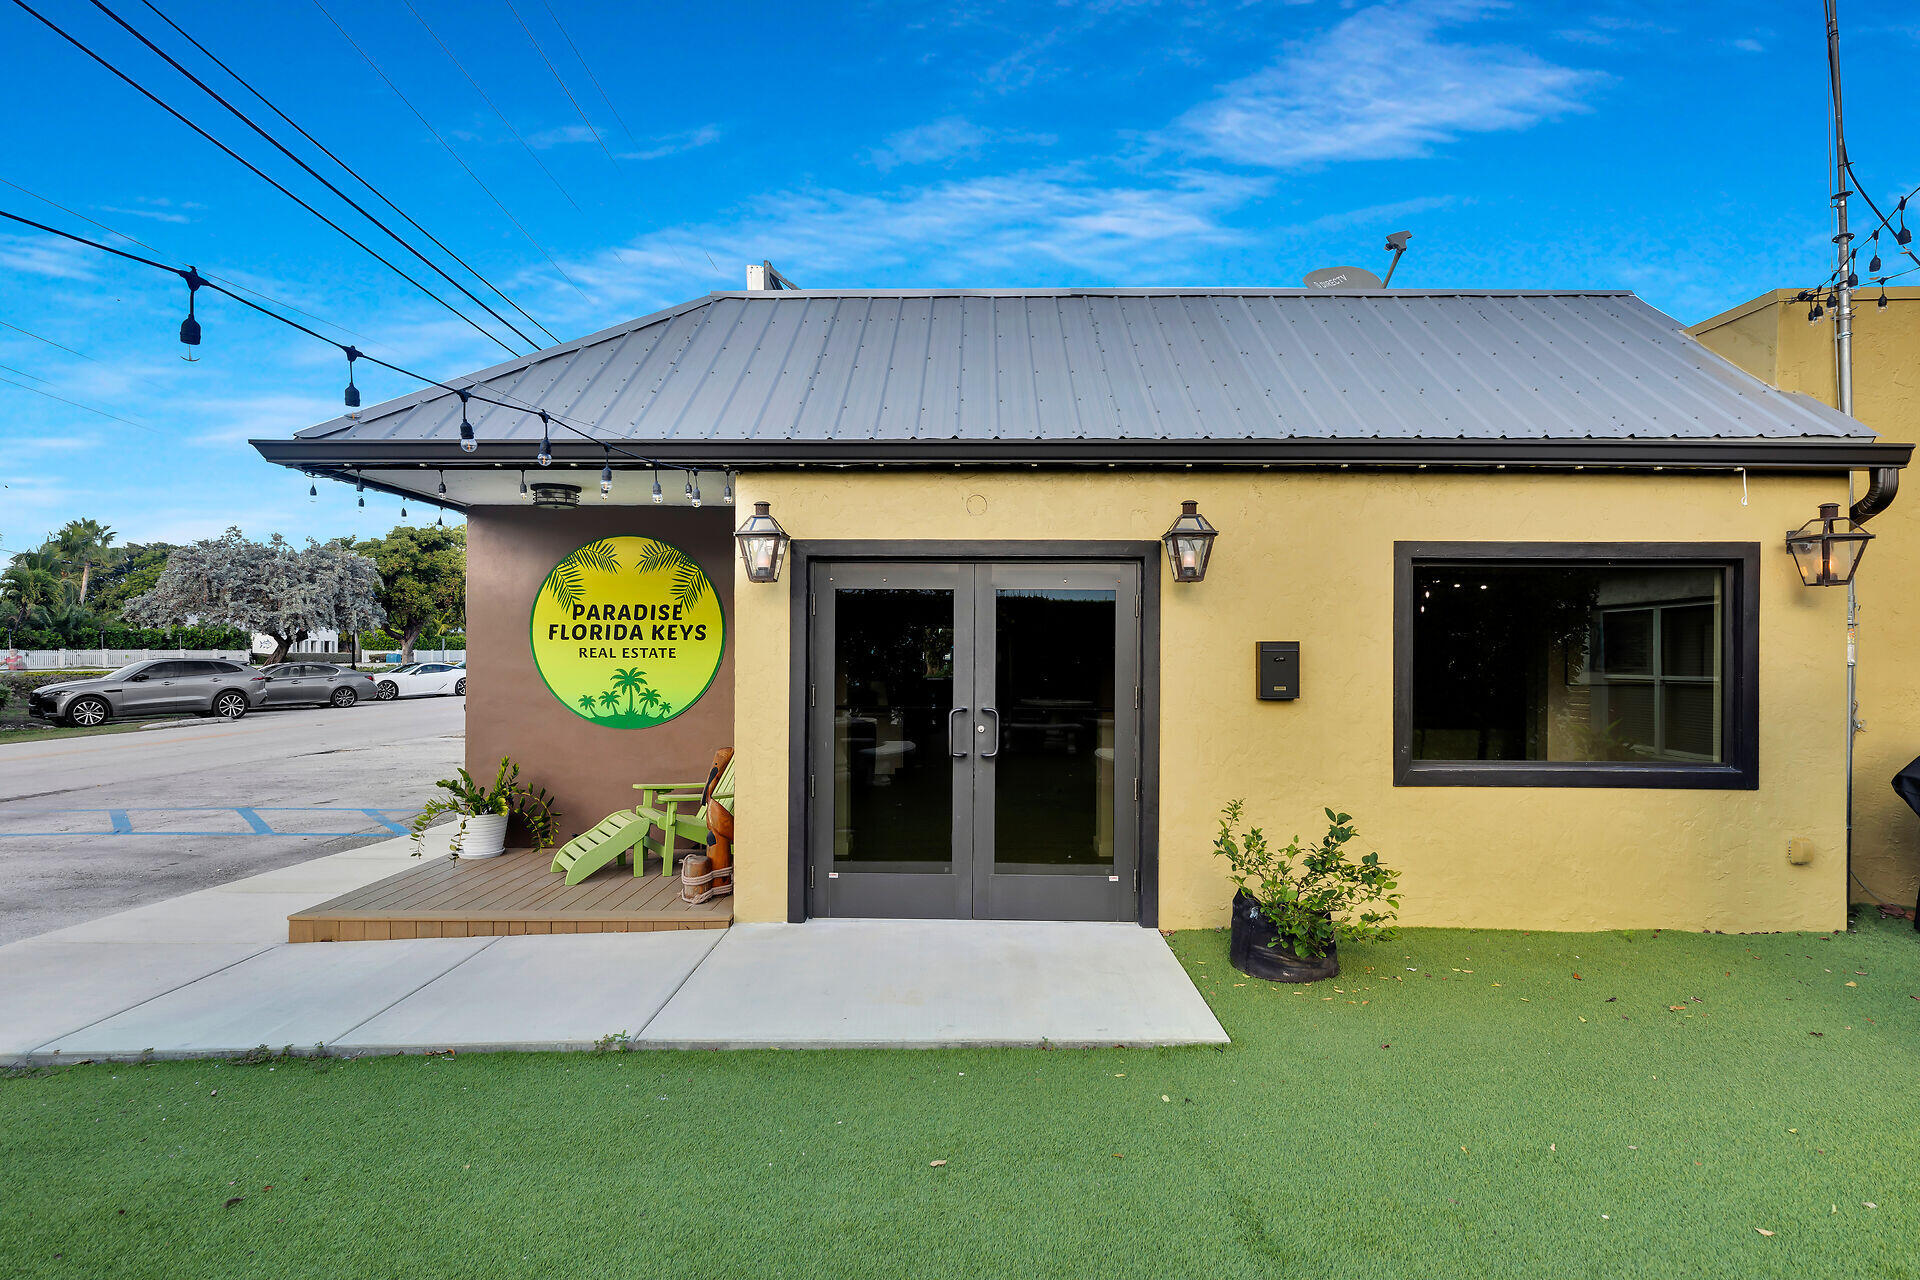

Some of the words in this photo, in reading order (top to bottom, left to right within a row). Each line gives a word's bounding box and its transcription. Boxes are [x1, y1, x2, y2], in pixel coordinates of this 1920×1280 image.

[572, 604, 683, 621] PARADISE
[548, 624, 643, 641] FLORIDA
[651, 624, 707, 641] KEYS
[579, 647, 617, 659] REAL
[622, 647, 676, 659] ESTATE
